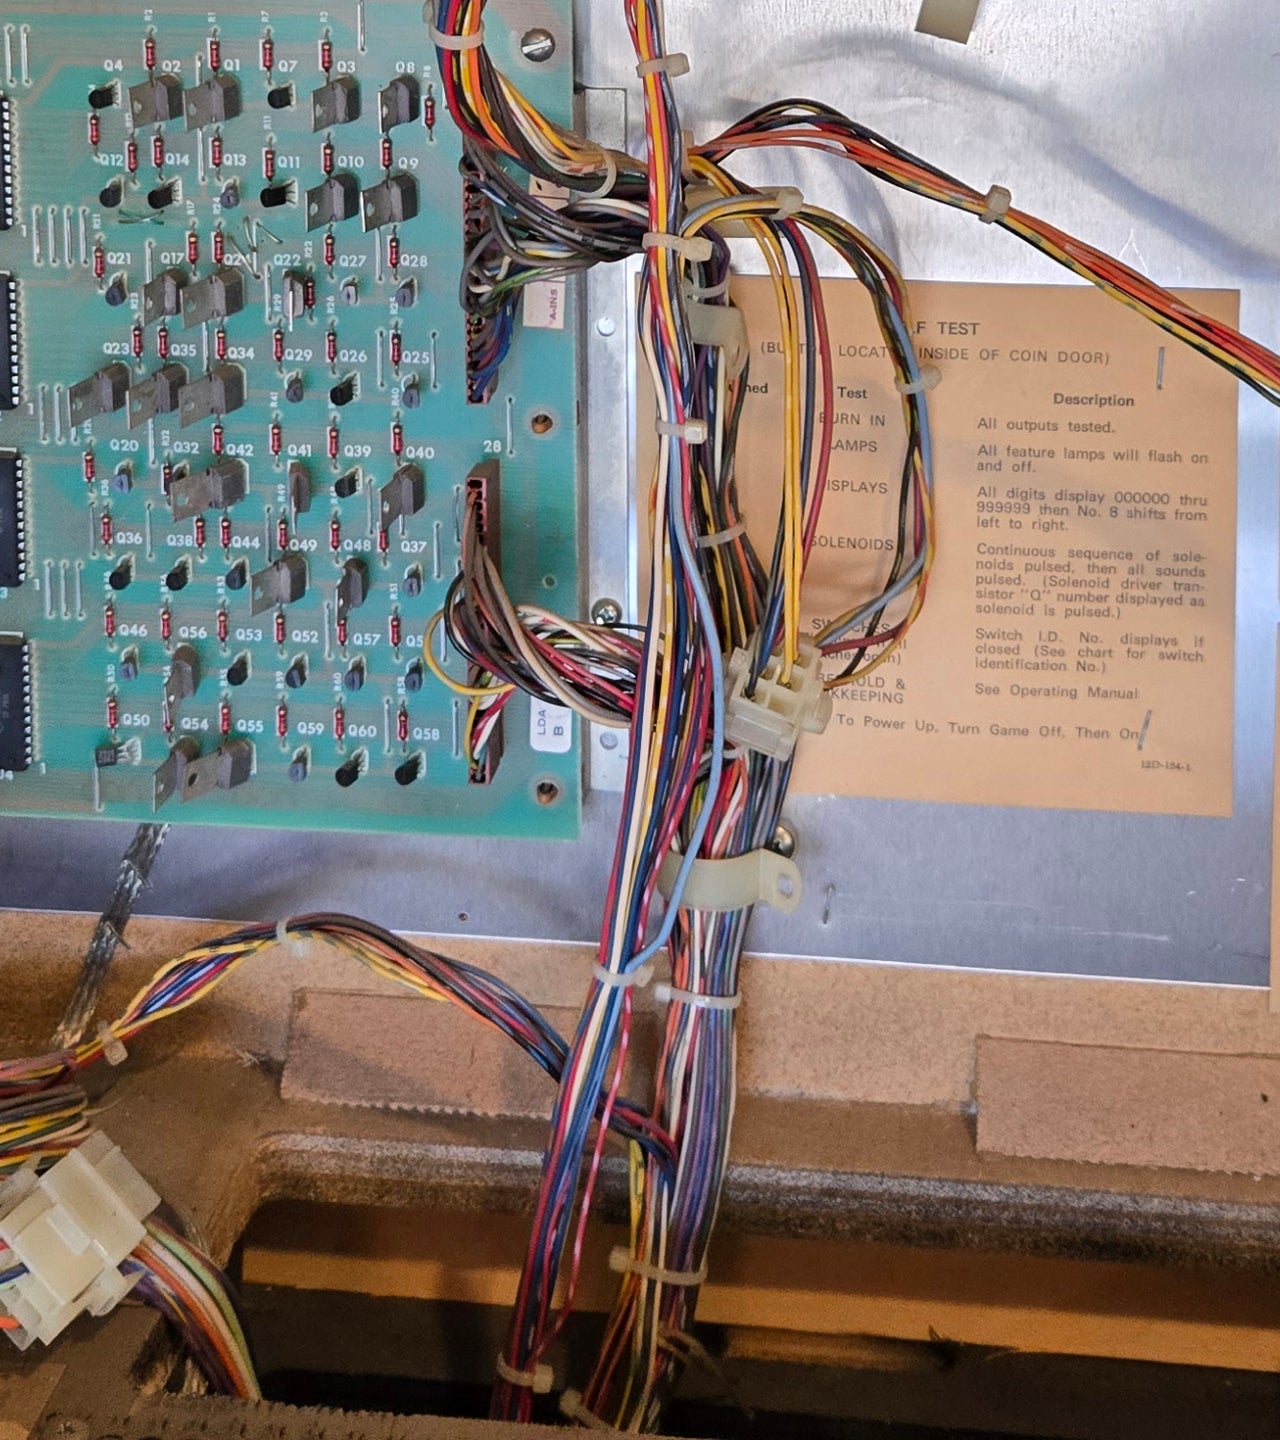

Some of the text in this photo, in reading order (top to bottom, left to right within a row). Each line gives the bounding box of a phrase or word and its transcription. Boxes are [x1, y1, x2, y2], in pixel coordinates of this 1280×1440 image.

[337, 155, 365, 169] Q10
[936, 321, 981, 336] TEST
[917, 346, 970, 360] INSIDE
[1009, 348, 1048, 363] COIN
[1057, 350, 1110, 367] DOOR)
[836, 385, 868, 400] Test
[1053, 392, 1135, 409] Description
[976, 416, 1116, 434] All outputs tested.
[225, 443, 254, 457] Q42
[483, 439, 502, 453] 28
[976, 443, 998, 457] All
[1005, 444, 1056, 459] feature
[1063, 446, 1106, 463] lamps
[1112, 448, 1139, 462] will
[1148, 449, 1183, 463] flash
[976, 501, 1031, 515] 999999
[1038, 503, 1070, 517] then
[1077, 504, 1102, 518] No.
[1126, 506, 1167, 521] shifts
[1174, 508, 1208, 522] from
[974, 682, 1139, 701] See Operating Manual
[296, 721, 325, 736] Q59
[863, 714, 906, 731] Power
[947, 721, 981, 735] Turn
[989, 723, 1030, 737] Game
[1038, 725, 1066, 739] Off,
[1074, 726, 1110, 740] Then
